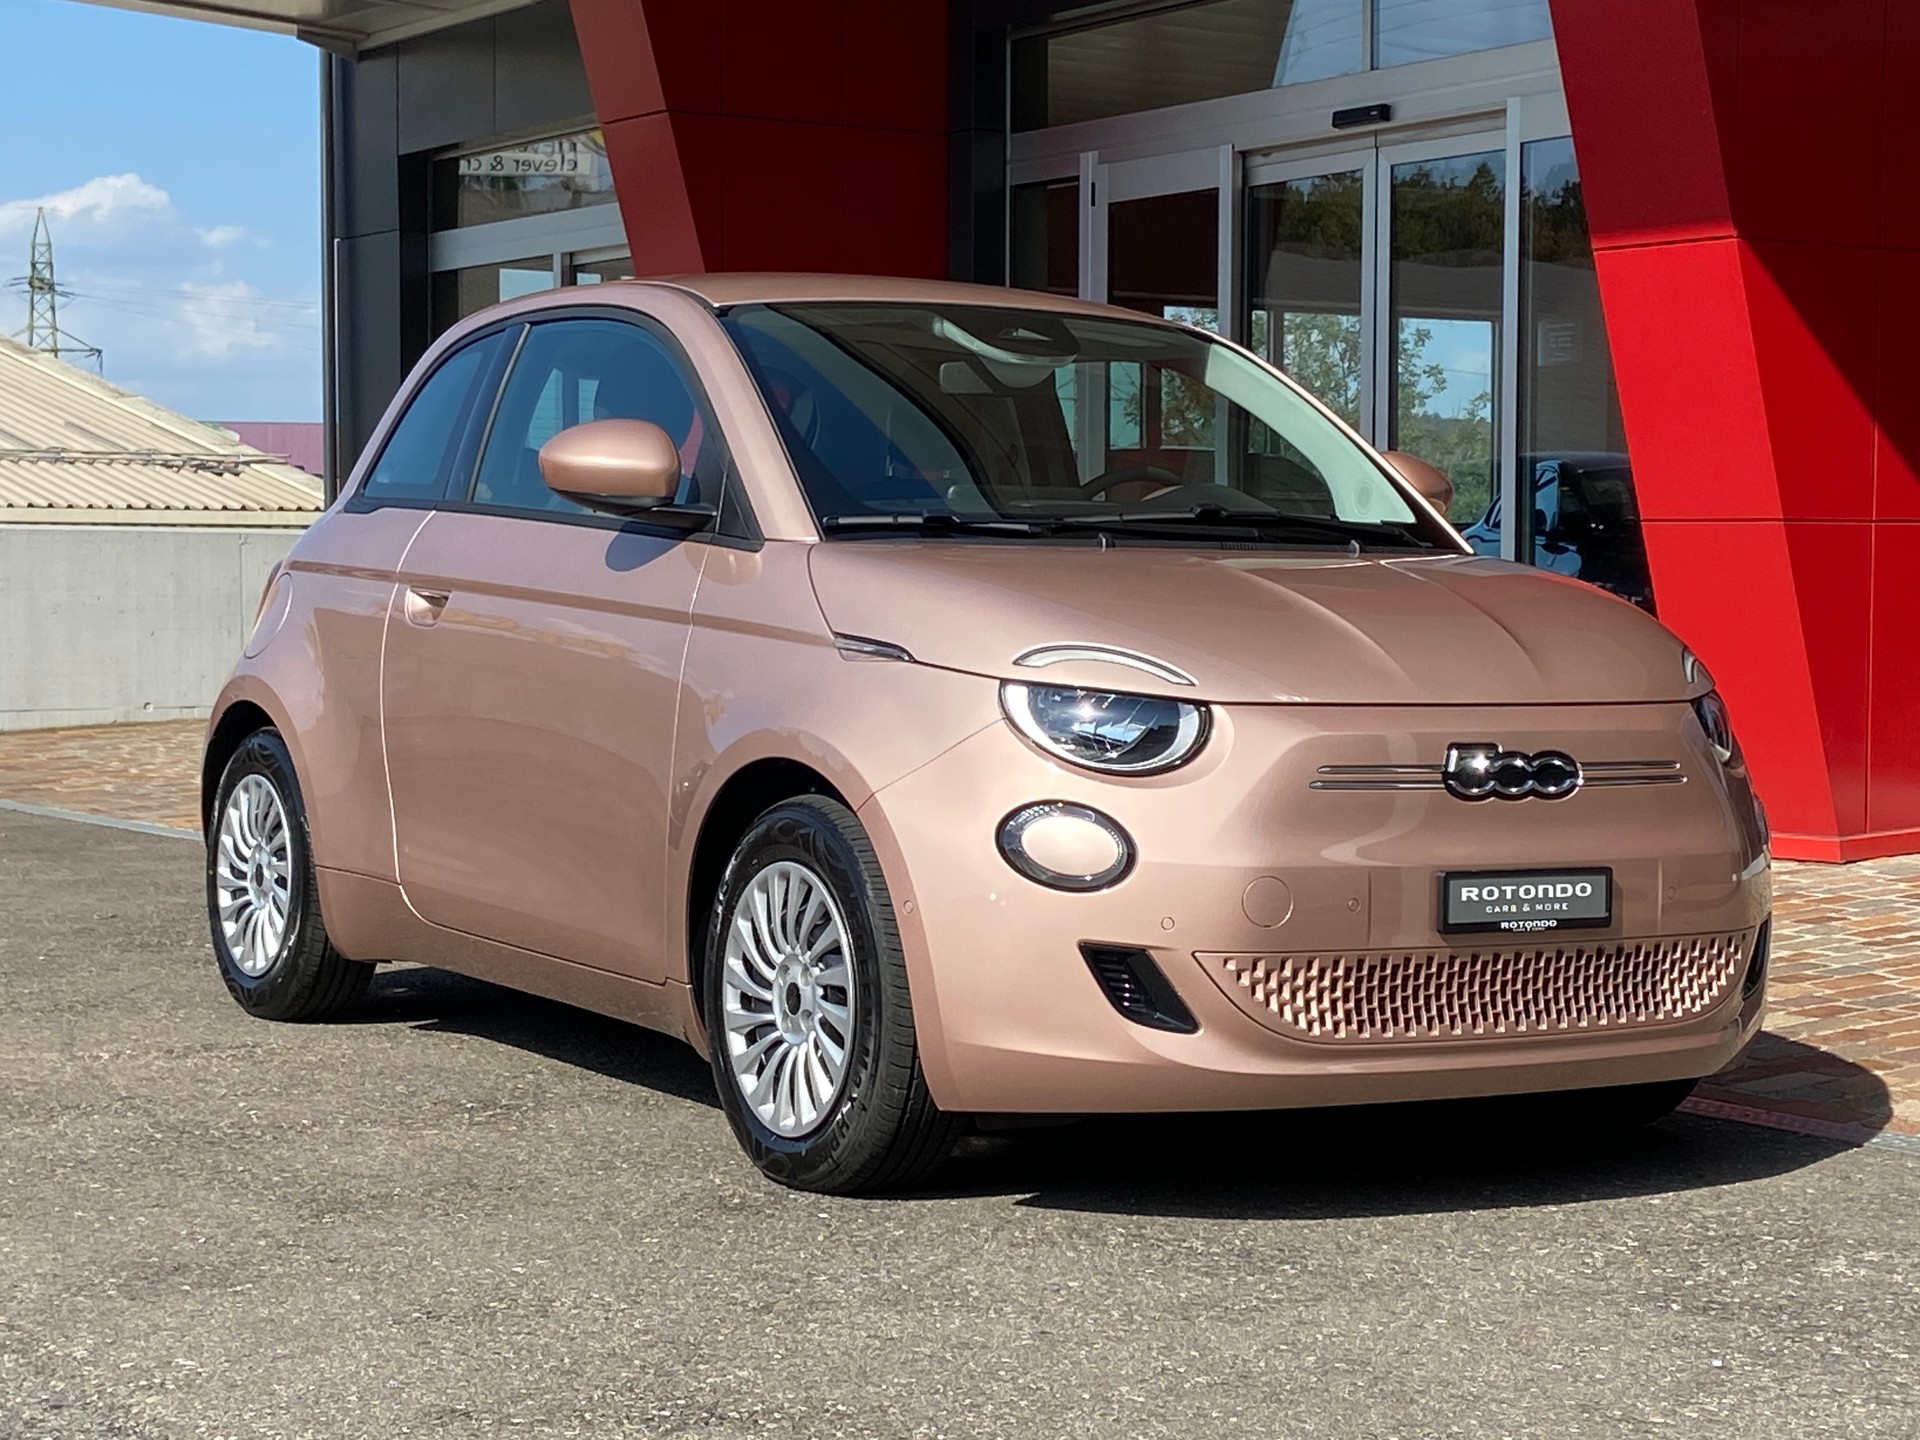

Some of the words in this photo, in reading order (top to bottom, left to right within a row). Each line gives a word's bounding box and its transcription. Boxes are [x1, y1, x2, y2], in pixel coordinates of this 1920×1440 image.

[1442, 742, 1582, 802] 500
[1461, 883, 1592, 902] ROTONDO
[1485, 904, 1518, 914] CARS
[1522, 902, 1531, 912] &
[1535, 902, 1569, 912] MORE
[1500, 919, 1558, 930] ROTONDO
